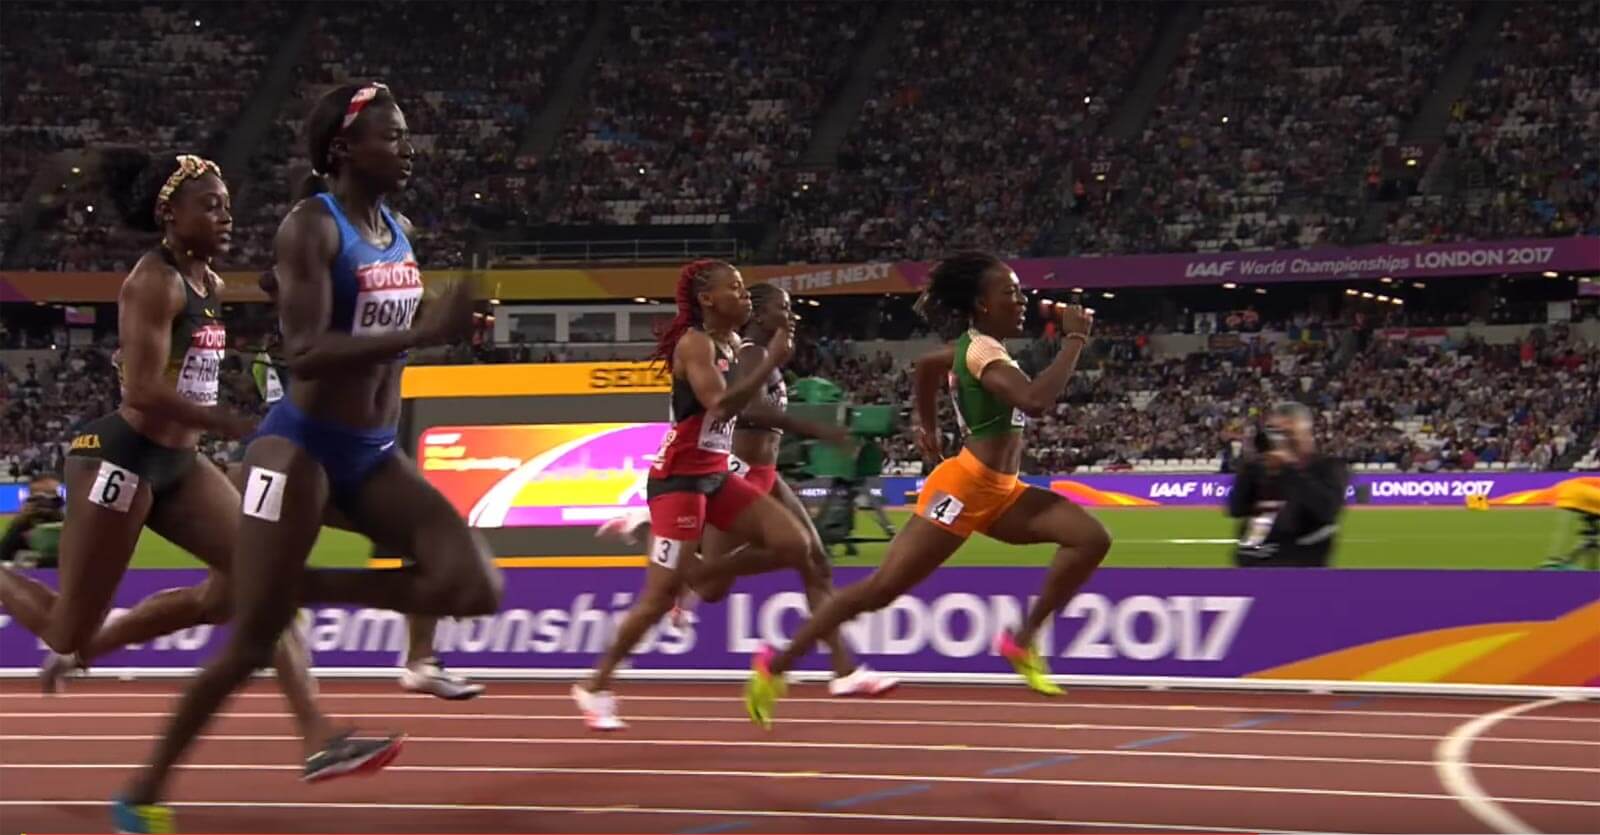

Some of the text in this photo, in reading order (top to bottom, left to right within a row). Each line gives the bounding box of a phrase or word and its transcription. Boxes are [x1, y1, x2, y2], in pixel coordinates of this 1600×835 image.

[1185, 248, 1555, 277] IAAF World Championships LONDON 2017
[364, 265, 422, 288] TOYOTA
[795, 270, 833, 289] THE
[836, 263, 893, 285] NEXT
[589, 368, 672, 389] SEIK
[102, 470, 125, 503] 6
[256, 474, 273, 513] 7
[1150, 482, 1234, 497] IAAF Wor
[1371, 481, 1449, 497] LONDON
[1451, 480, 1495, 497] 2017
[934, 497, 953, 520] 4
[657, 540, 672, 564] 3
[1063, 596, 1255, 662] 2017
